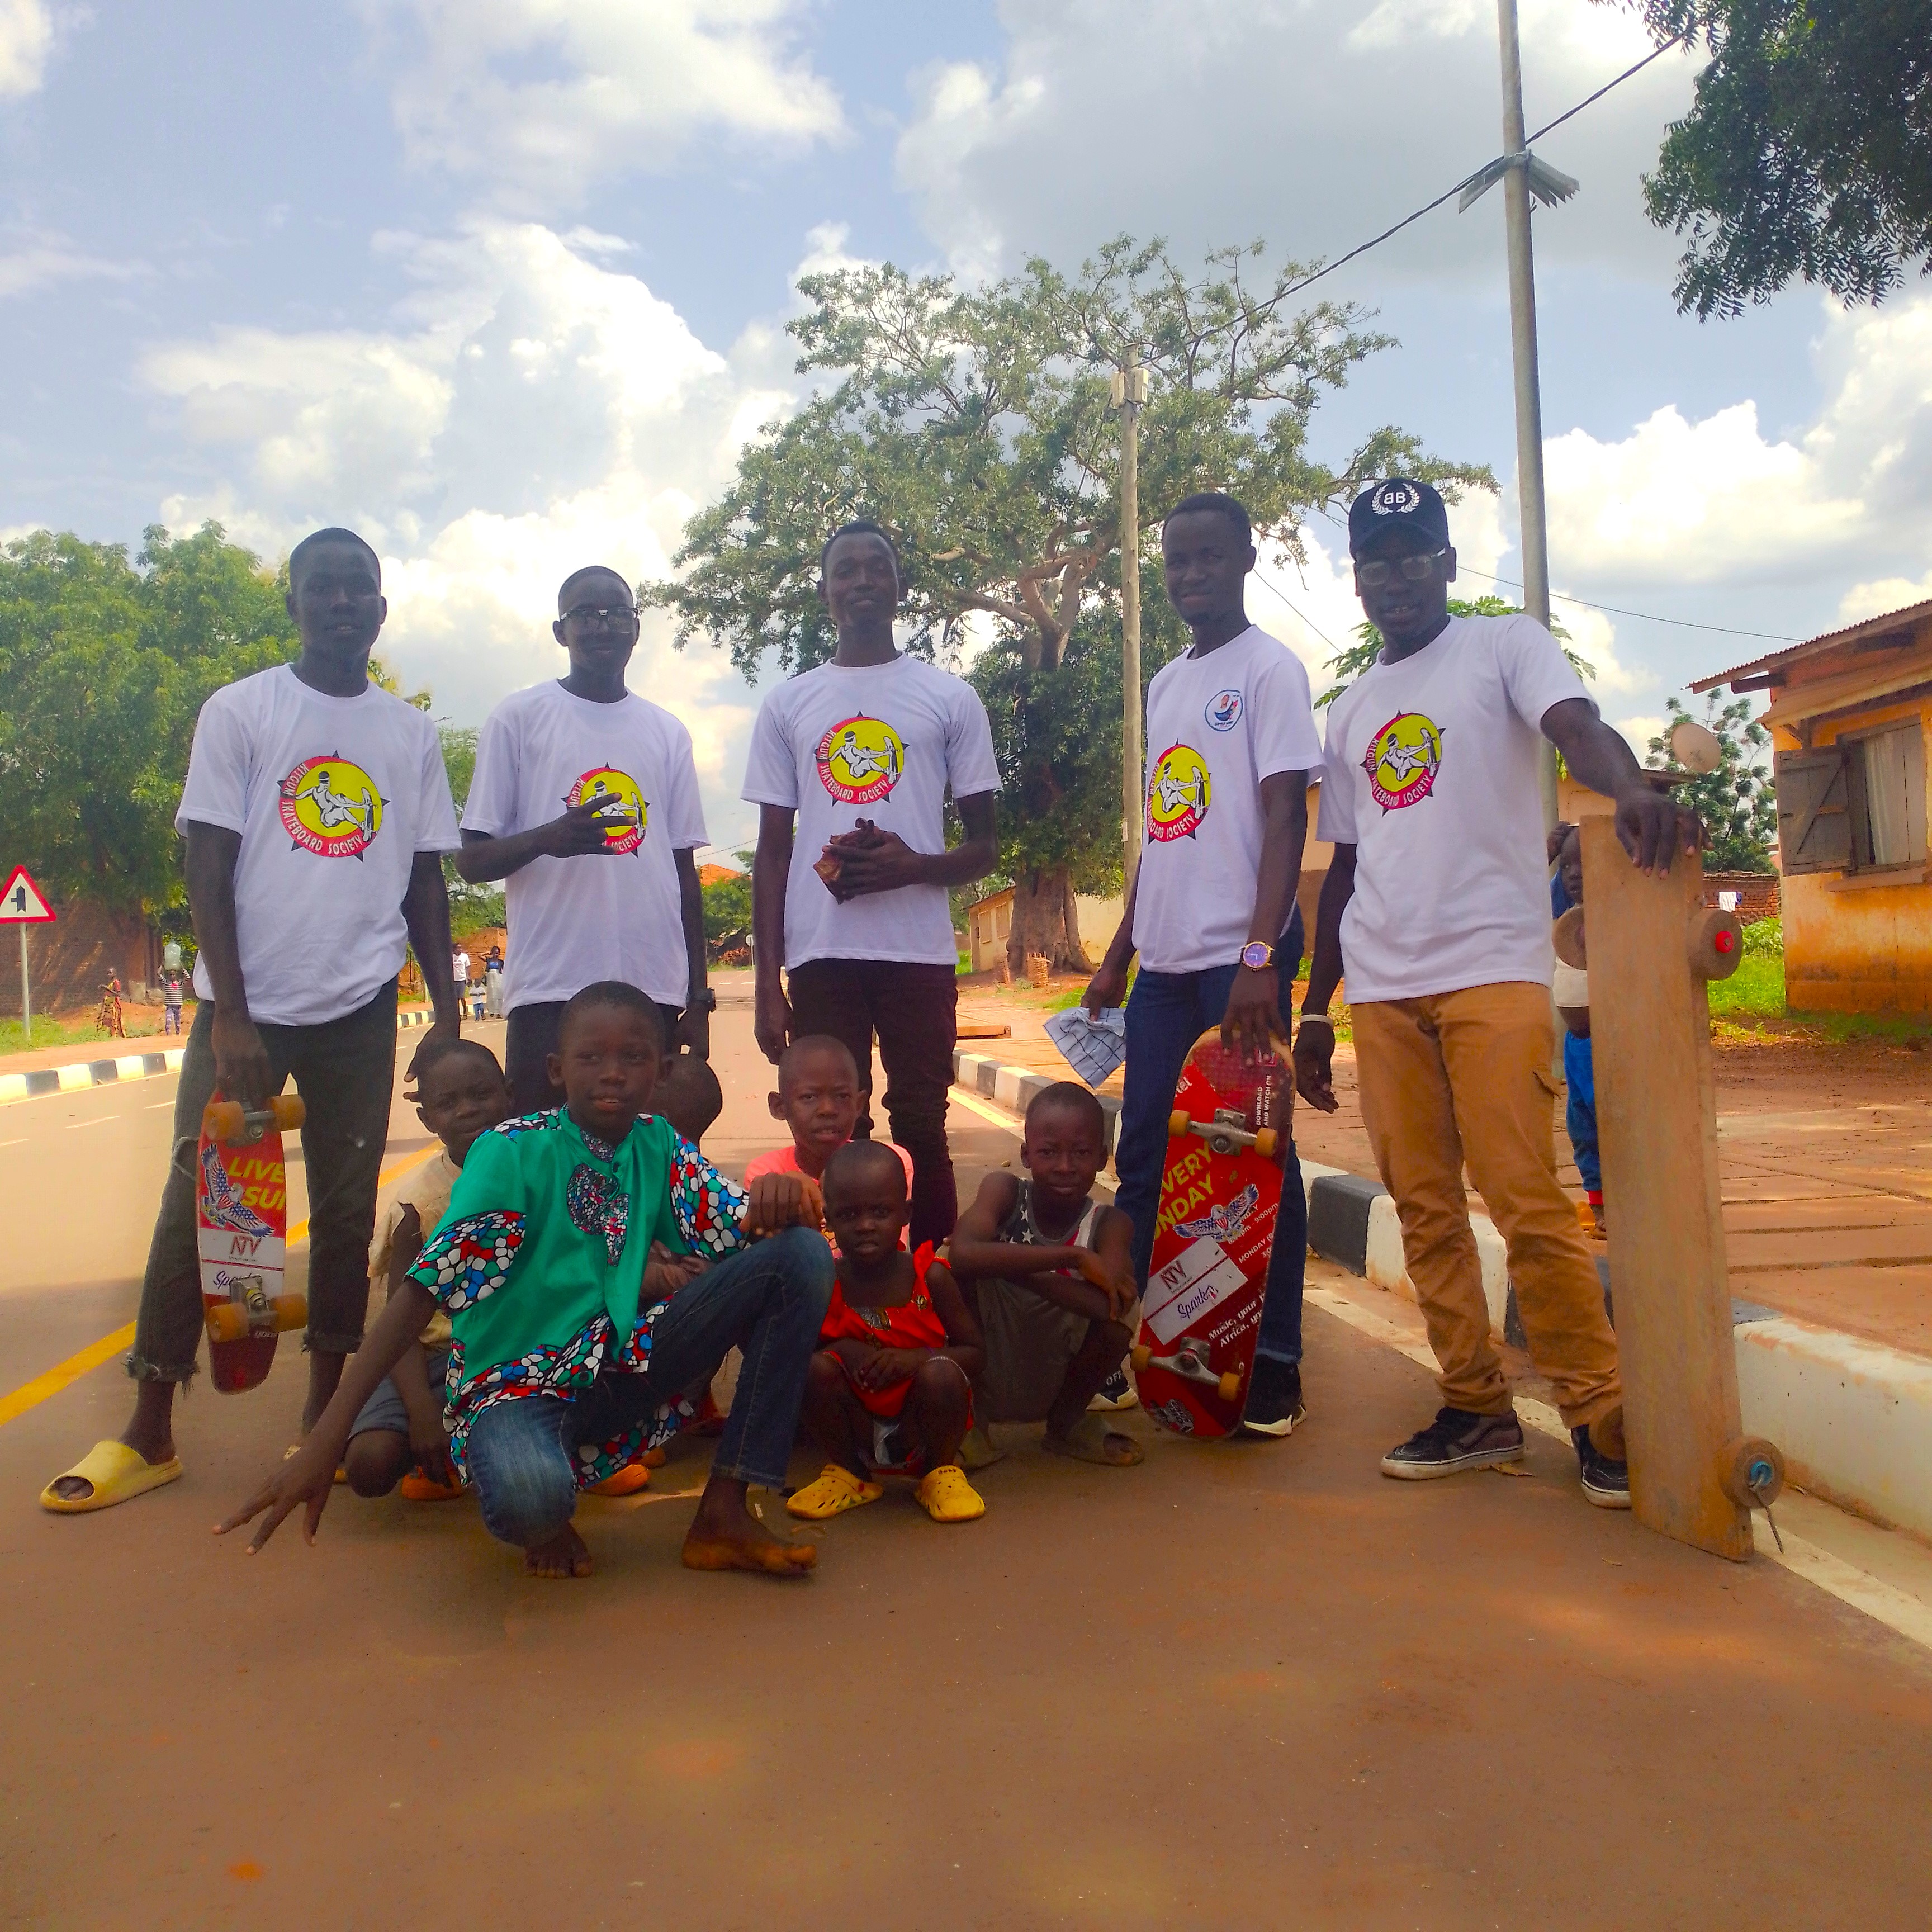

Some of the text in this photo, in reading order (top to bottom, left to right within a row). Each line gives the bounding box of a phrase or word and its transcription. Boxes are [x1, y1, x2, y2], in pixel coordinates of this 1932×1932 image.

[819, 730, 837, 760] KITGUM
[1367, 738, 1380, 772] KITGUM
[282, 763, 310, 796] KITGUM
[820, 764, 854, 801] SKATEBOARD
[858, 779, 889, 802] SOCIETY
[1403, 775, 1431, 805] SOCIETY
[281, 801, 323, 852] SKATEBOARD
[1166, 813, 1195, 840] SOCIETY
[328, 835, 363, 855] SOCIETY
[227, 1157, 285, 1183] LIVE
[1253, 1202, 1279, 1224] 9:00pm
[1238, 1239, 1266, 1263] MONDAY
[1208, 1319, 1237, 1341] Music,
[1237, 1301, 1257, 1319] your
[1220, 1323, 1250, 1348] Africa,
[1106, 1370, 1121, 1385] OFF
